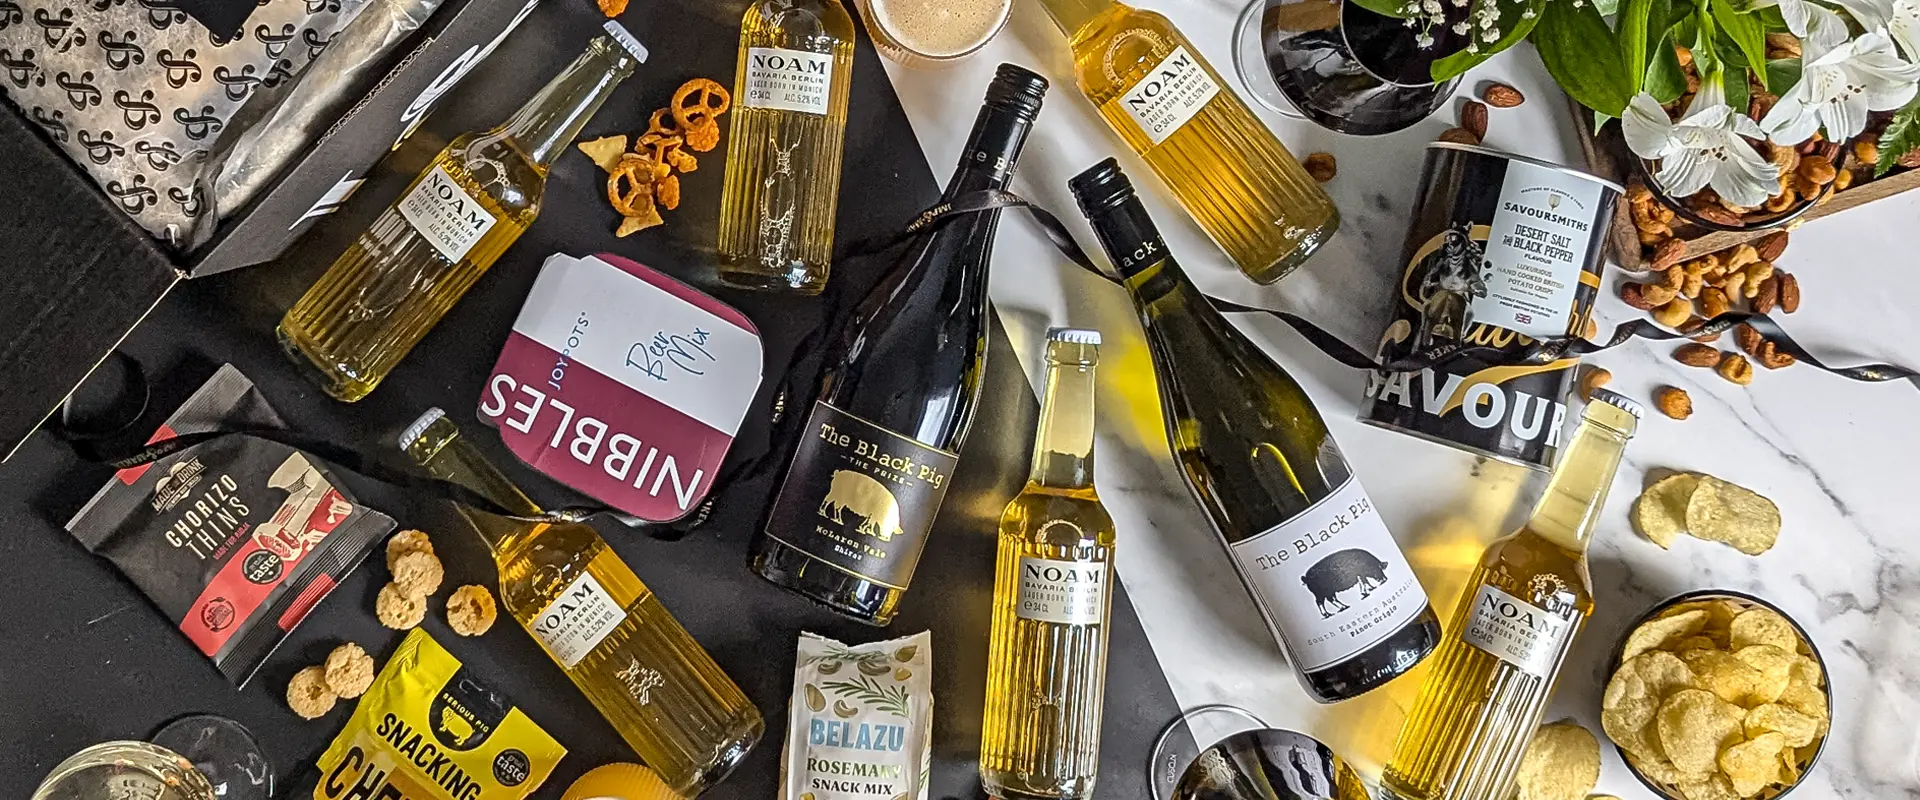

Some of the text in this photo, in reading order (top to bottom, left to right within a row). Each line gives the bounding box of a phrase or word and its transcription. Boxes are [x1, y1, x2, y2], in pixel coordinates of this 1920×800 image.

[752, 55, 825, 74] NOAM
[752, 71, 823, 84] BAVARIA BERLIN
[751, 80, 767, 88] LAGER
[769, 81, 786, 89] BORN
[798, 84, 822, 93] MUNICH
[1128, 54, 1191, 112] NOAM
[1140, 67, 1197, 118] BAVARIA BERLIN
[1146, 74, 1204, 126] LAGER BORN IN MUNICH
[421, 185, 474, 238] BAVARIA BERLIN
[427, 173, 486, 231] NOAM
[1504, 202, 1588, 232] SAVOURSMITHS
[426, 205, 440, 219] BORN
[446, 224, 468, 244] MUNICH
[1514, 224, 1572, 248] DESERT SALT
[1513, 237, 1543, 254] BLACK
[1544, 244, 1574, 263] PEPPER
[1524, 254, 1552, 264] FLAVOUR
[1496, 266, 1564, 289] HAND COOKED BRITISH
[1508, 278, 1554, 294] POTATO CRISPS
[1516, 263, 1552, 278] LUXURIOUS
[549, 316, 589, 390] JOYPOTS
[626, 330, 669, 381] Beer
[666, 327, 716, 376] Mix
[481, 373, 704, 510] NIBBLES
[819, 423, 944, 489] The Black Pig
[152, 484, 176, 512] MADE
[177, 459, 204, 482] DRINK
[165, 474, 238, 549] CHORIZO
[185, 495, 250, 560] THINS
[816, 525, 886, 558] McLaren Vale
[1255, 497, 1372, 571] The Black Pig
[249, 554, 280, 581] taste
[835, 545, 862, 561] Shiraz
[1024, 563, 1099, 583] NOAM
[1024, 581, 1065, 591] BAVARIA
[536, 581, 594, 640] NOAM
[585, 602, 607, 624] MUNICH
[1023, 591, 1043, 600] LAGER
[1046, 593, 1064, 602] BORN
[1308, 577, 1414, 646] South Eastern Australia
[548, 595, 600, 646] BAVARIA BERLIN
[1350, 605, 1398, 638] Pinot Grigio
[1474, 617, 1494, 631] LAGER
[1493, 627, 1512, 639] BORN
[1478, 609, 1515, 631] BAVARIA
[1482, 592, 1560, 638] NOAM
[442, 692, 490, 734] SERIOUS PIG
[809, 718, 905, 752] BELAZU
[376, 712, 482, 800] SNACKING
[496, 756, 526, 782] taste
[806, 758, 902, 778] ROSEMARY
[812, 778, 894, 796] SNACK MIX
